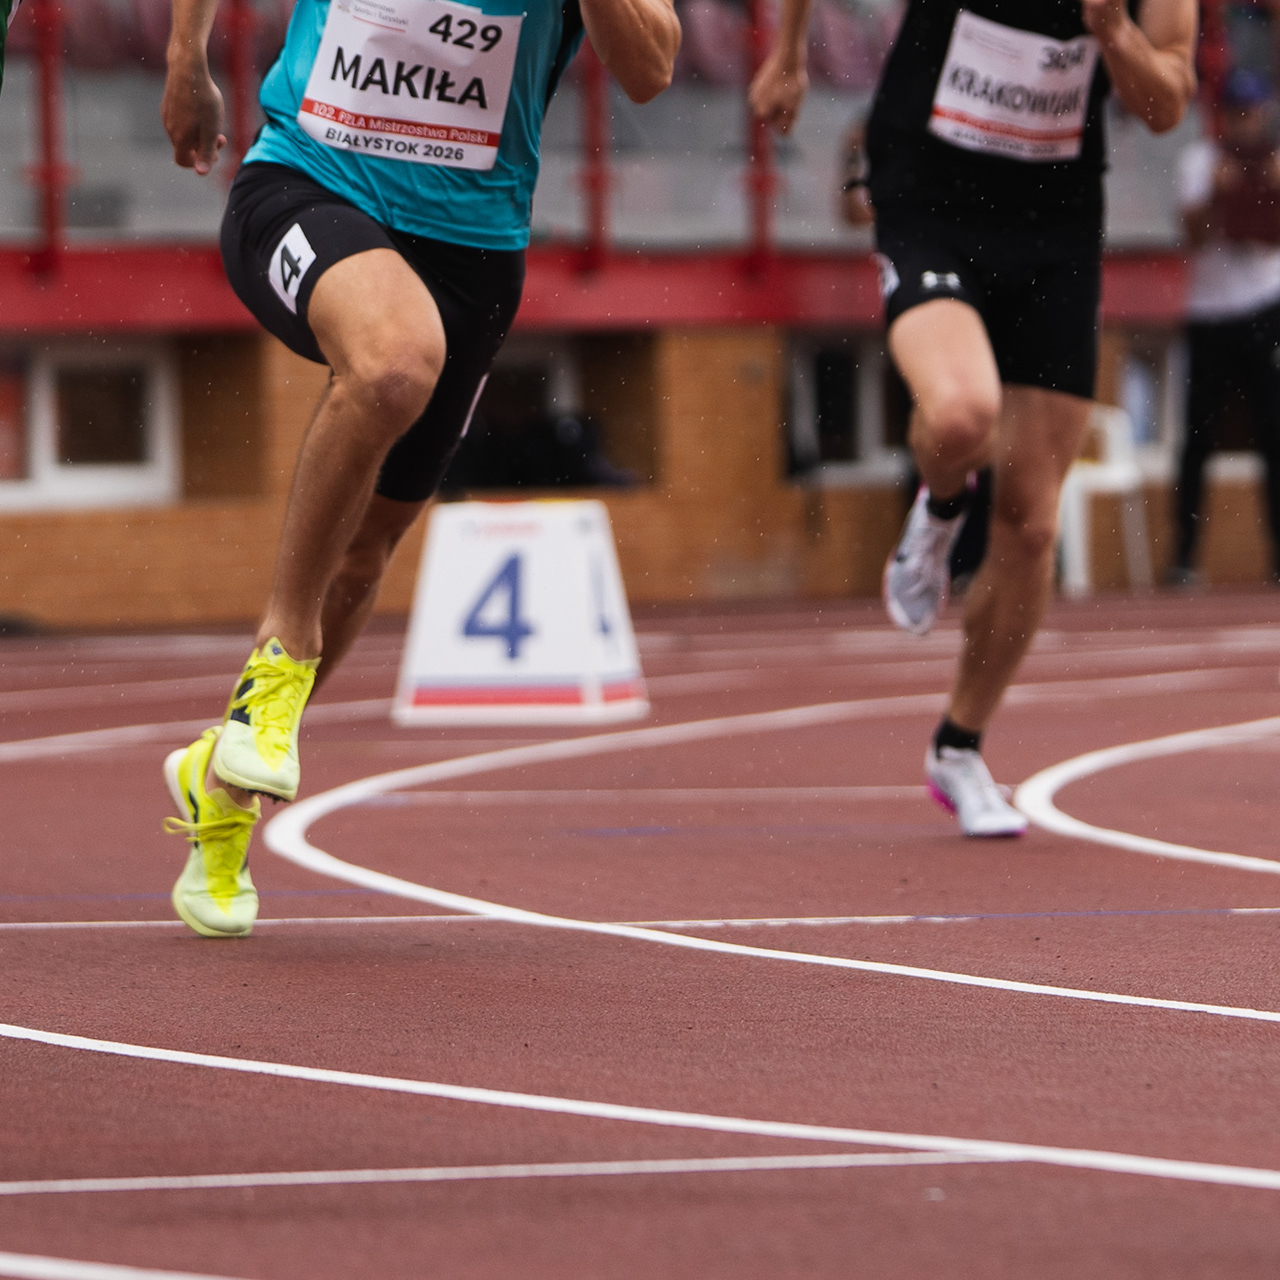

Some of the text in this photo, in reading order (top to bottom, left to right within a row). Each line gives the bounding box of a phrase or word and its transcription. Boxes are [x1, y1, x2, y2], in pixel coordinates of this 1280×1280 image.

[429, 14, 503, 52] 429
[330, 46, 488, 109] MAKIŁA
[326, 127, 464, 161] BIAŁYSTOK 2026
[339, 111, 366, 128] PZLA
[369, 119, 447, 140] Mistrzostwa
[450, 129, 489, 144] Polski
[281, 244, 302, 293] 4
[461, 552, 535, 661] 4
